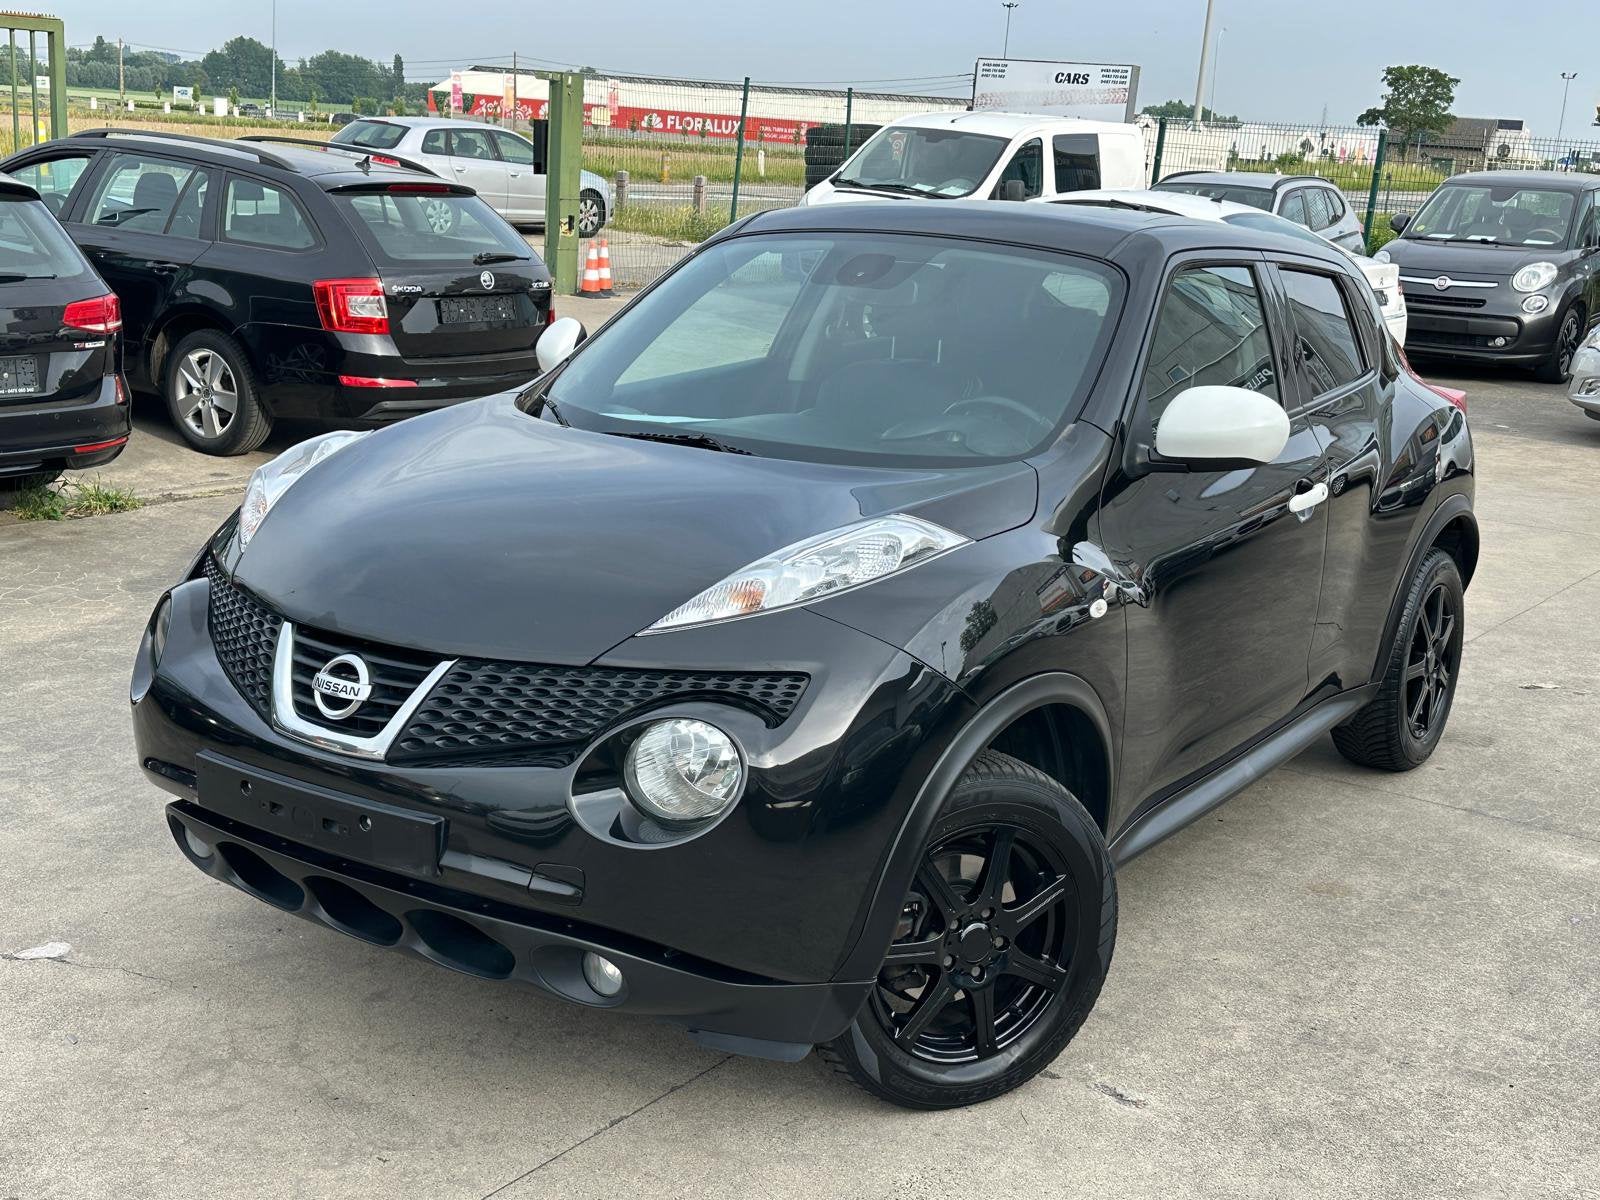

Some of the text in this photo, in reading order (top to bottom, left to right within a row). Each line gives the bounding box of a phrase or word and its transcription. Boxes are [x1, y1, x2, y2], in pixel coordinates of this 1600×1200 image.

[1054, 71, 1090, 85] CARS
[667, 114, 742, 134] FLORALUX
[314, 676, 361, 697] NISSAN
